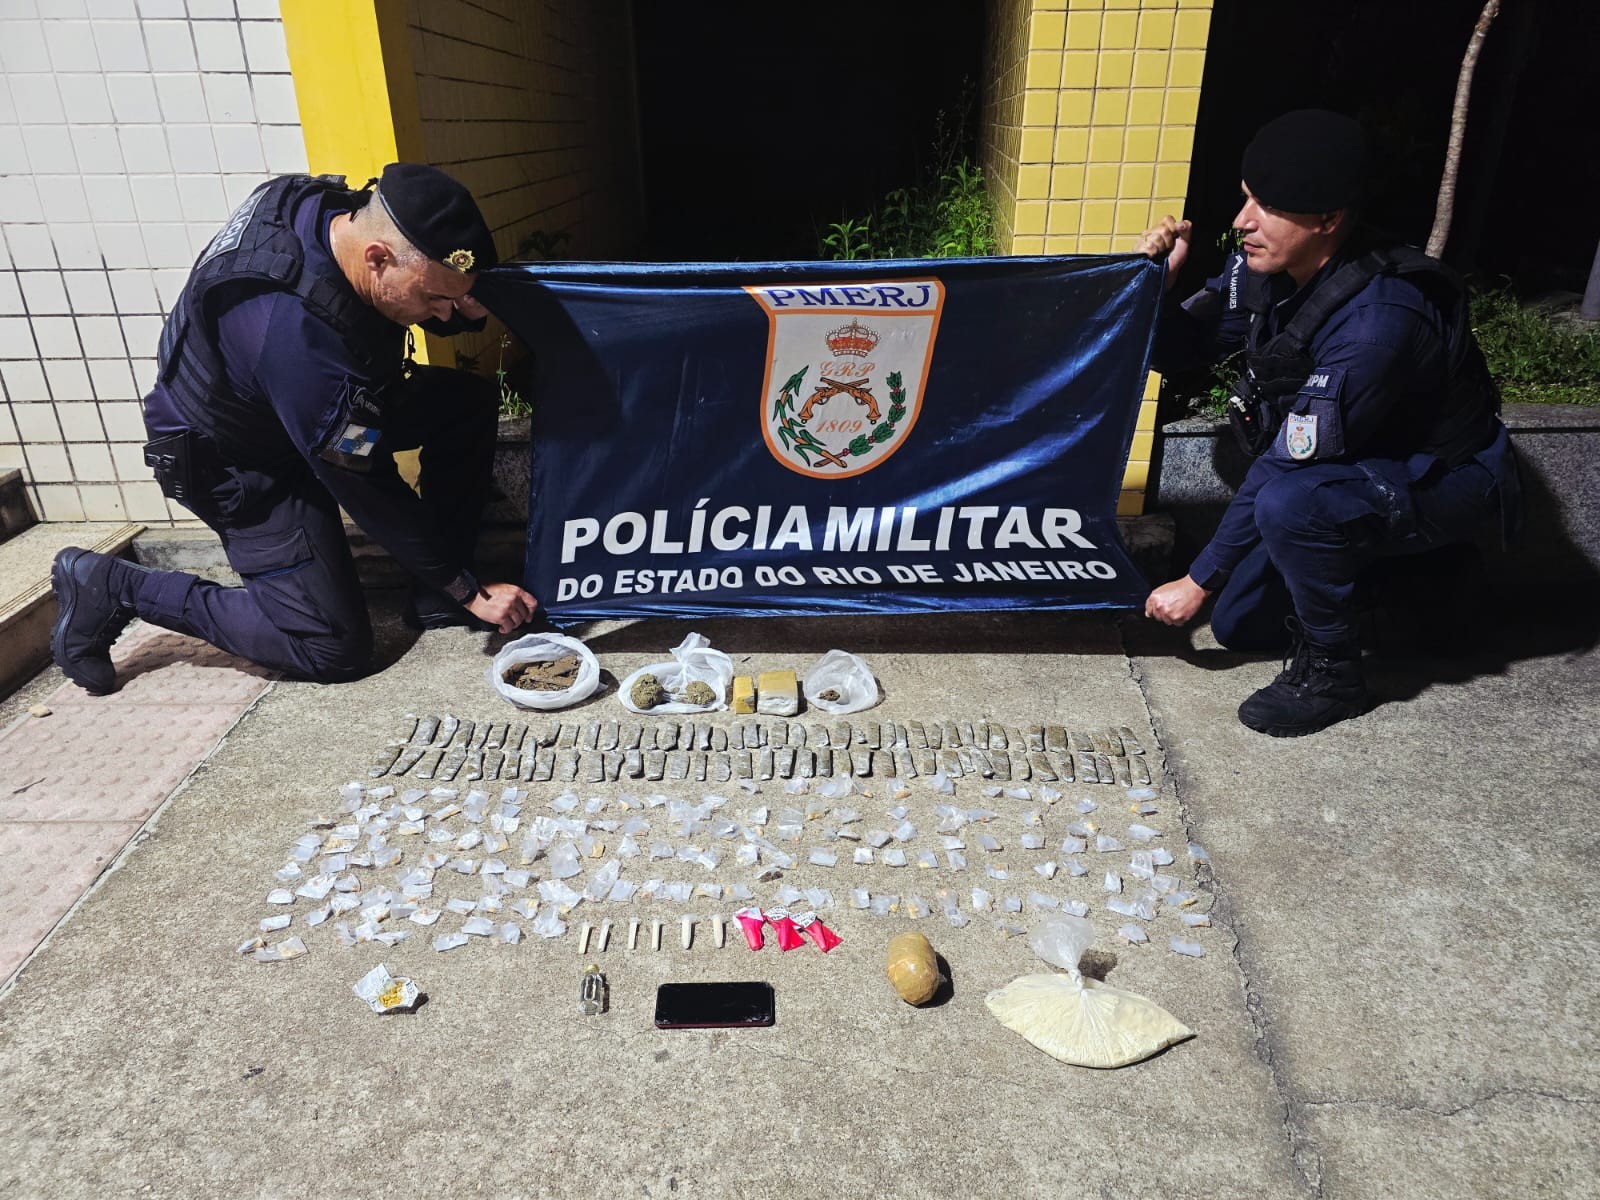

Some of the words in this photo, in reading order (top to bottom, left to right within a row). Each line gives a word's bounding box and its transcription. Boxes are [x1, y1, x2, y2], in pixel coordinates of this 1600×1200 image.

[763, 285, 931, 307] PMERJ
[1229, 276, 1238, 310] MARQUES
[815, 419, 864, 434] 1809
[561, 497, 813, 564] POLÍCIA
[822, 506, 1098, 551] MILITAR
[556, 574, 604, 602] DO
[613, 566, 744, 594] ESTADO
[754, 565, 807, 587] DO
[812, 566, 882, 585] RIO
[886, 564, 945, 584] DE
[952, 560, 1118, 583] JANEIRO
